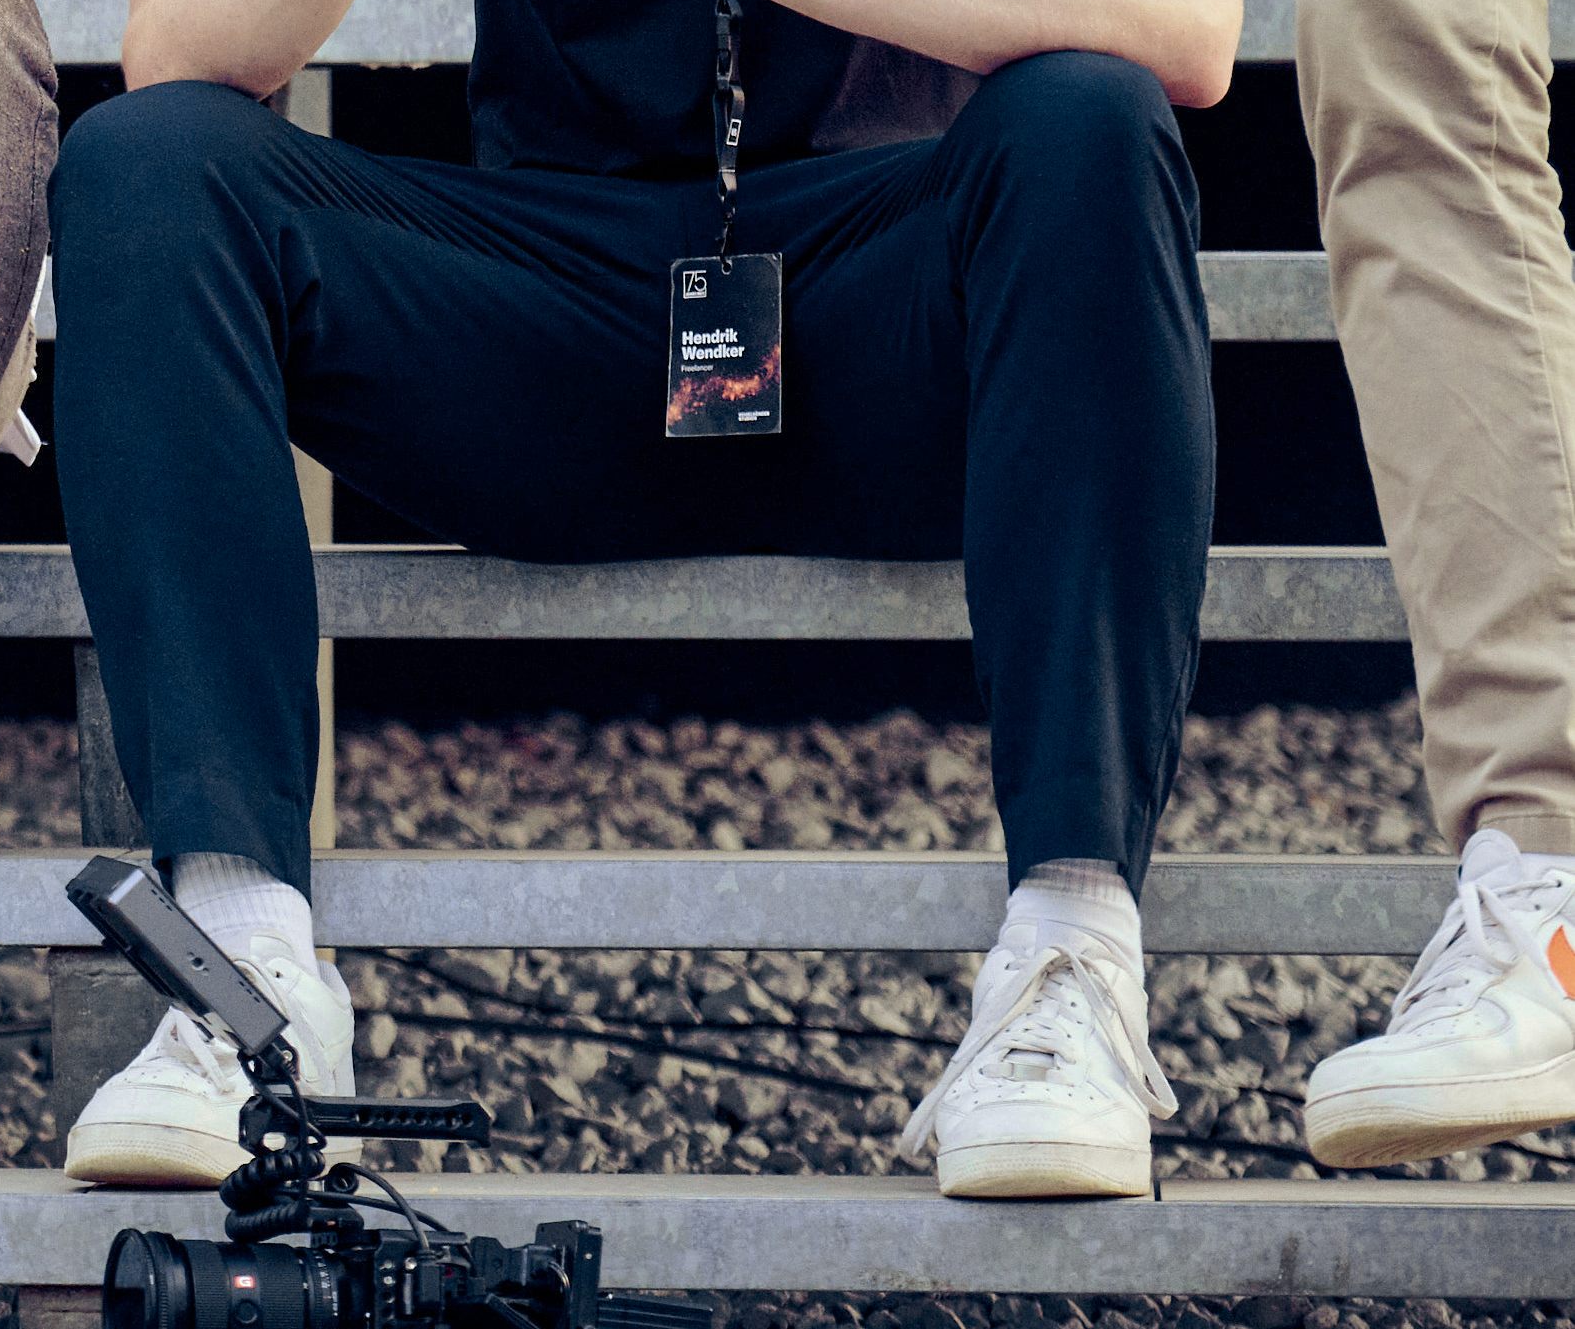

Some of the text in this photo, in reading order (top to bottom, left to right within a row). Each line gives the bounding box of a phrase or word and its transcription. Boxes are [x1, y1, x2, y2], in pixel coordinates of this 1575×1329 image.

[683, 270, 707, 292] 75
[682, 328, 738, 345] Hendrik
[682, 345, 745, 360] Wendker
